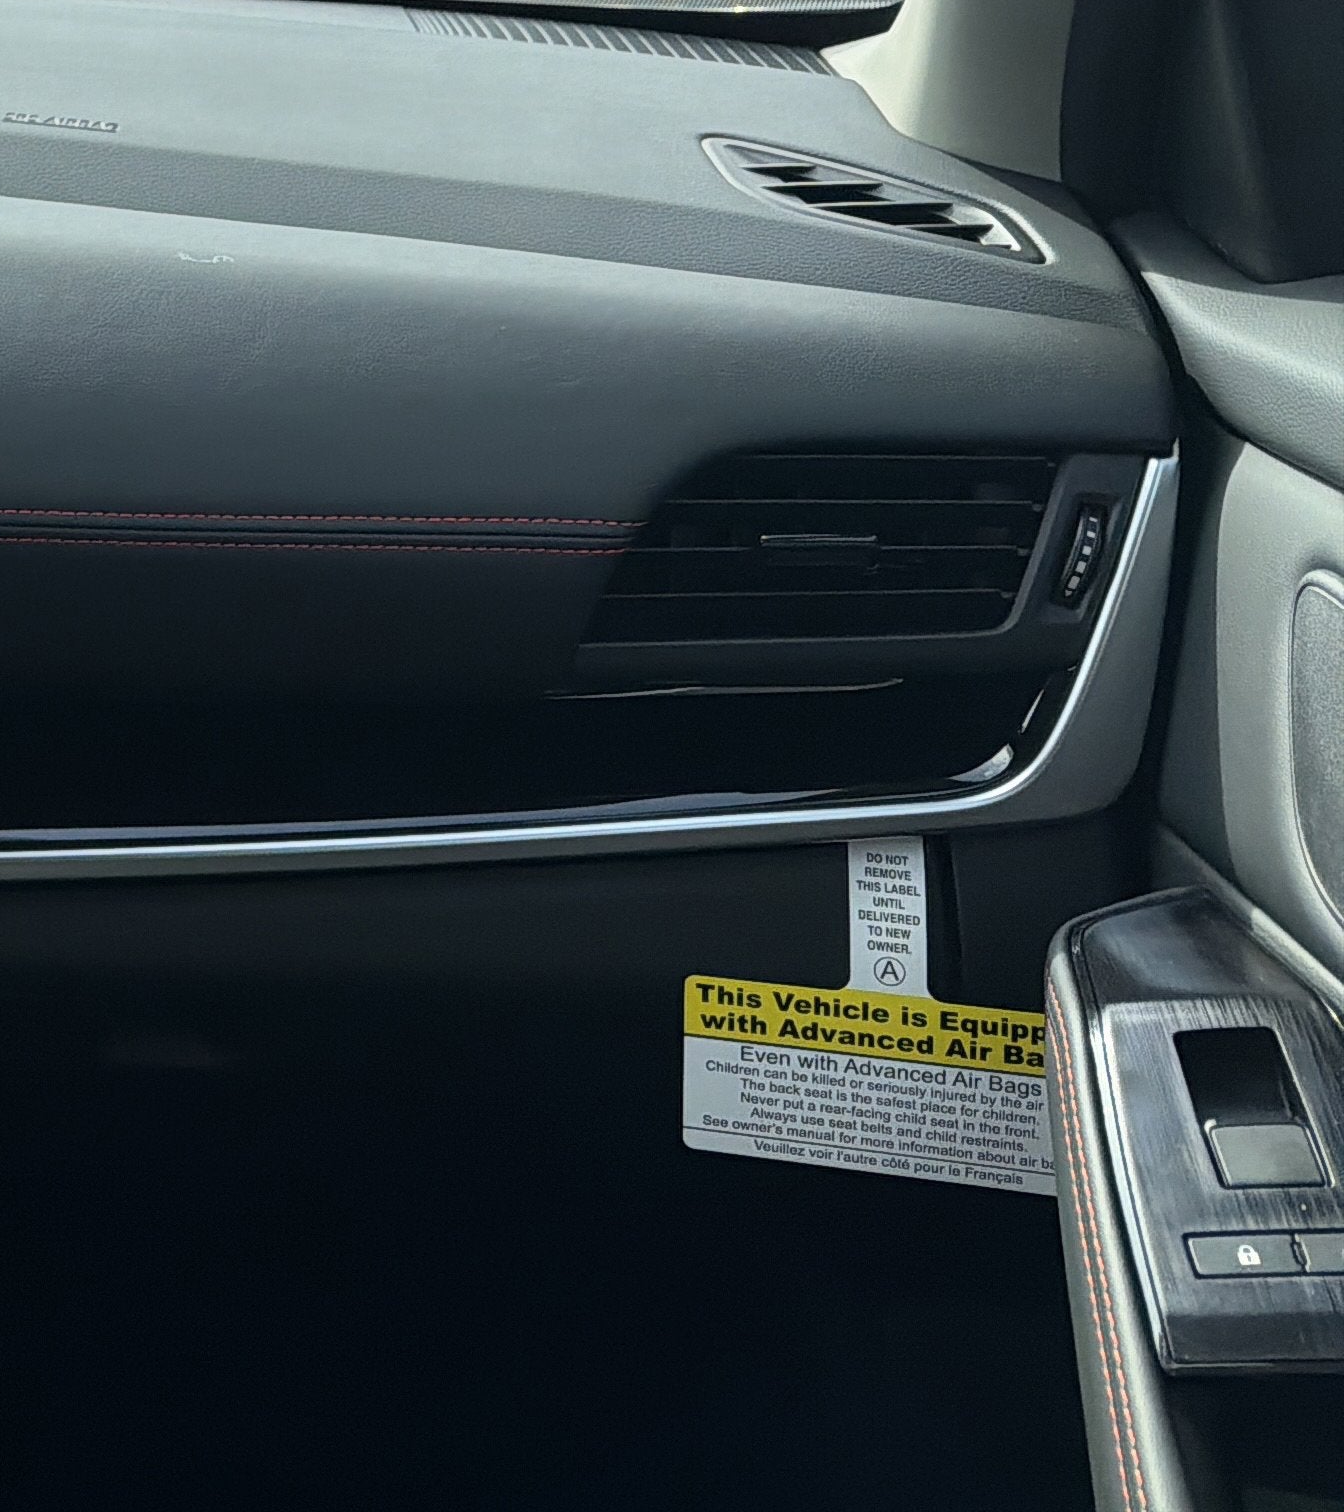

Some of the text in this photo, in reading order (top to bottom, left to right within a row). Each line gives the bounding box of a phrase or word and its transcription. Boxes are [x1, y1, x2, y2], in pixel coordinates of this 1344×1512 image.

[864, 866, 912, 882] REMOVE
[866, 852, 909, 867] DO NOT
[856, 879, 921, 897] THIS LABEL
[872, 896, 905, 910] UNTIL
[858, 909, 921, 926] DELIVERED
[867, 925, 911, 941] TO NEW
[867, 939, 912, 955] OWNER.
[880, 960, 900, 982] A
[695, 982, 1045, 1045] This Vehicle is Equipp
[700, 1012, 1045, 1068] with Advanced Air Ba
[705, 1060, 1044, 1112] Children can be killed or seriously injured by the air
[740, 1045, 1042, 1099] Even with Advanced Air Bags
[740, 1077, 1040, 1126] The back seat is the safest place for children.
[740, 1091, 1040, 1140] Never put a rear-facing child seat in the front.
[702, 1114, 728, 1128] See
[732, 1120, 783, 1135] owner's
[786, 1127, 835, 1142] manual
[839, 1132, 856, 1145] for
[860, 1136, 894, 1149] more
[898, 1139, 973, 1160] information
[977, 1151, 1015, 1165] about
[1019, 1156, 1036, 1168] air
[750, 1107, 1028, 1153] Always use seat belts and child restraints.
[754, 1139, 1023, 1185] Veuillez voir l'autre côté pour le Français
